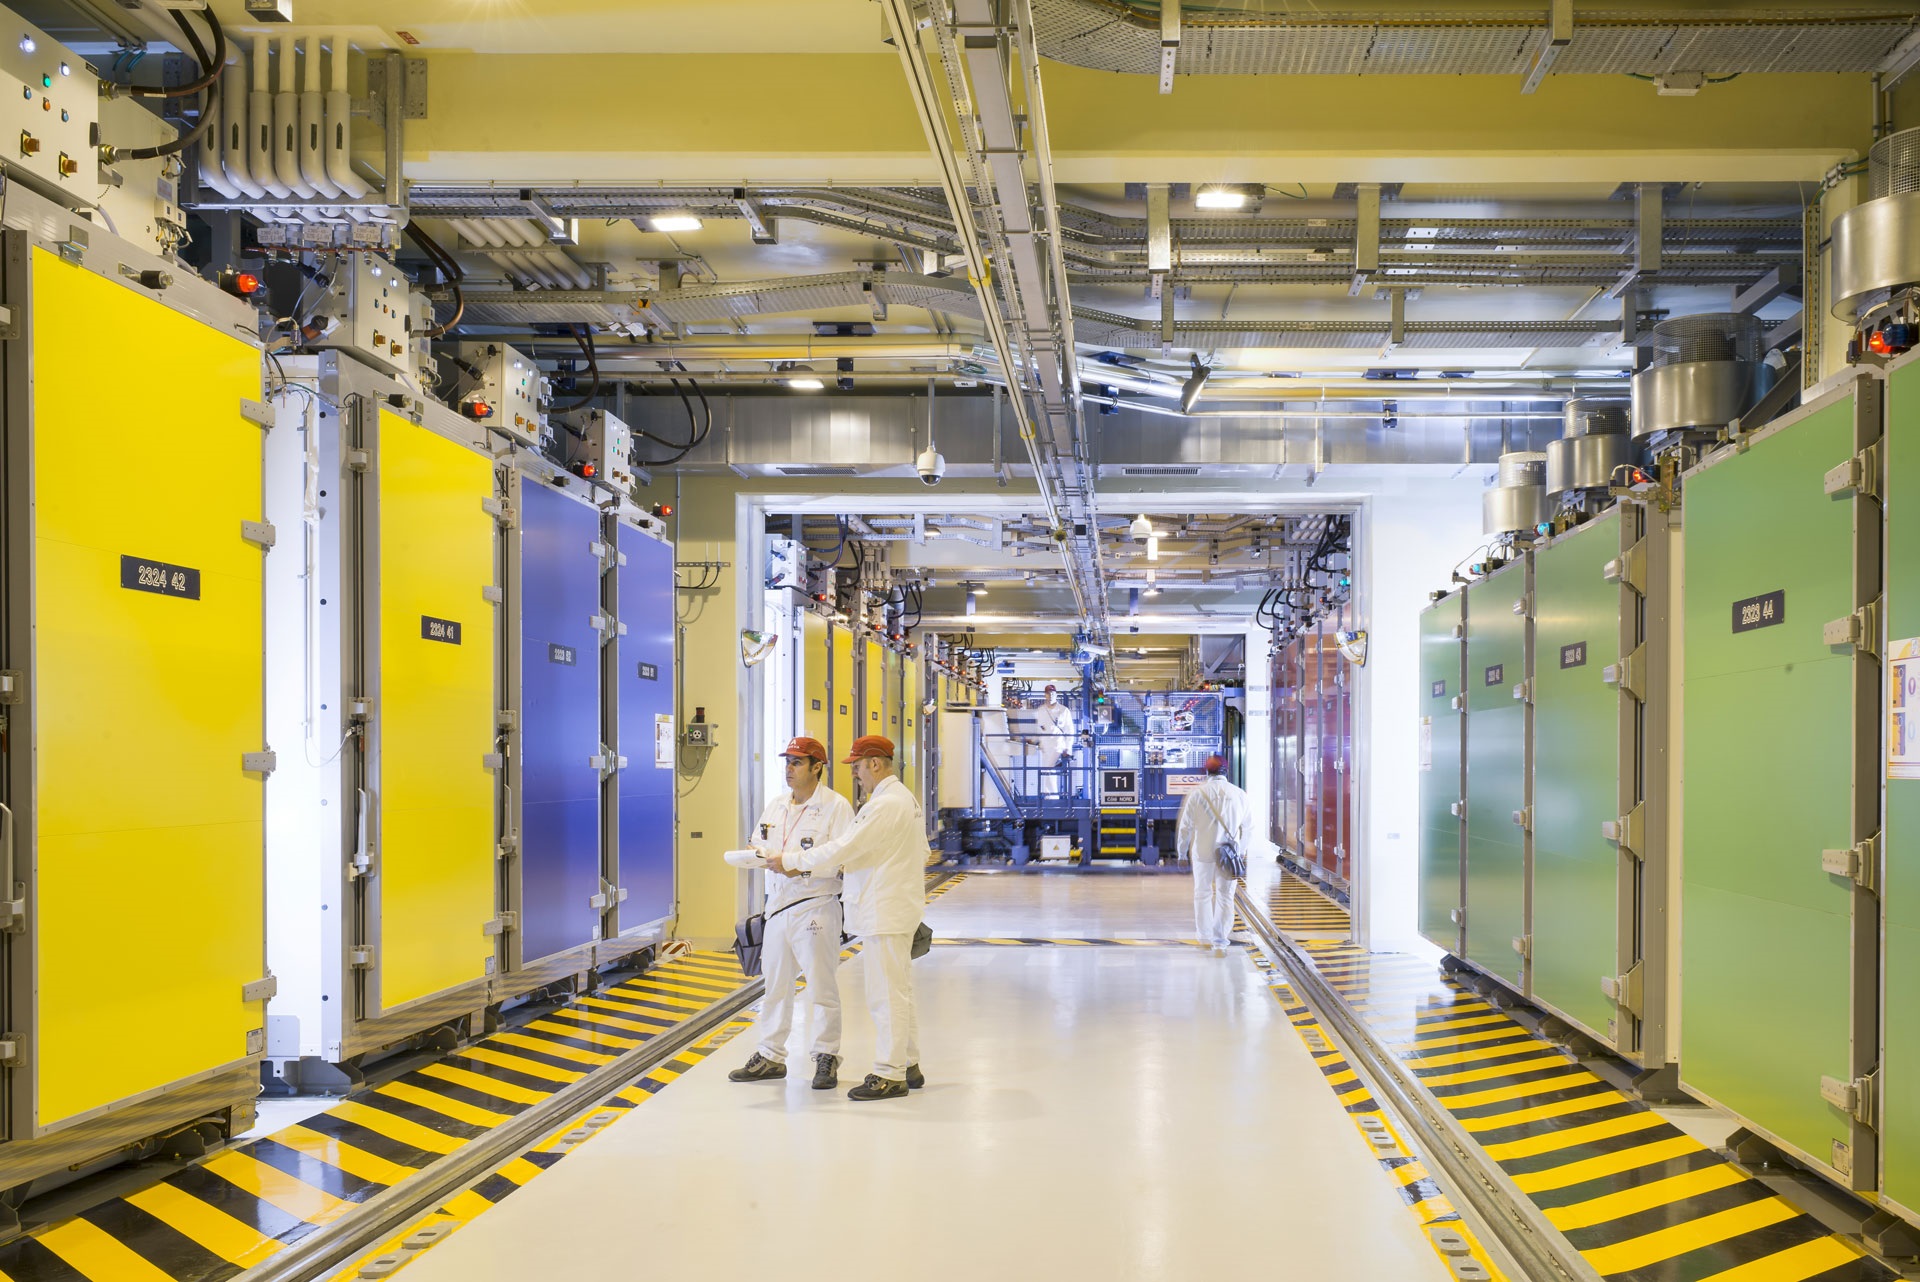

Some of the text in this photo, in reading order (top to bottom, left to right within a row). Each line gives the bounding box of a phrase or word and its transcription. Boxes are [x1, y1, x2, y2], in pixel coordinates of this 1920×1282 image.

[138, 565, 186, 591] 2324 42
[1742, 599, 1774, 625] 2323 44
[1112, 776, 1127, 788] T1
